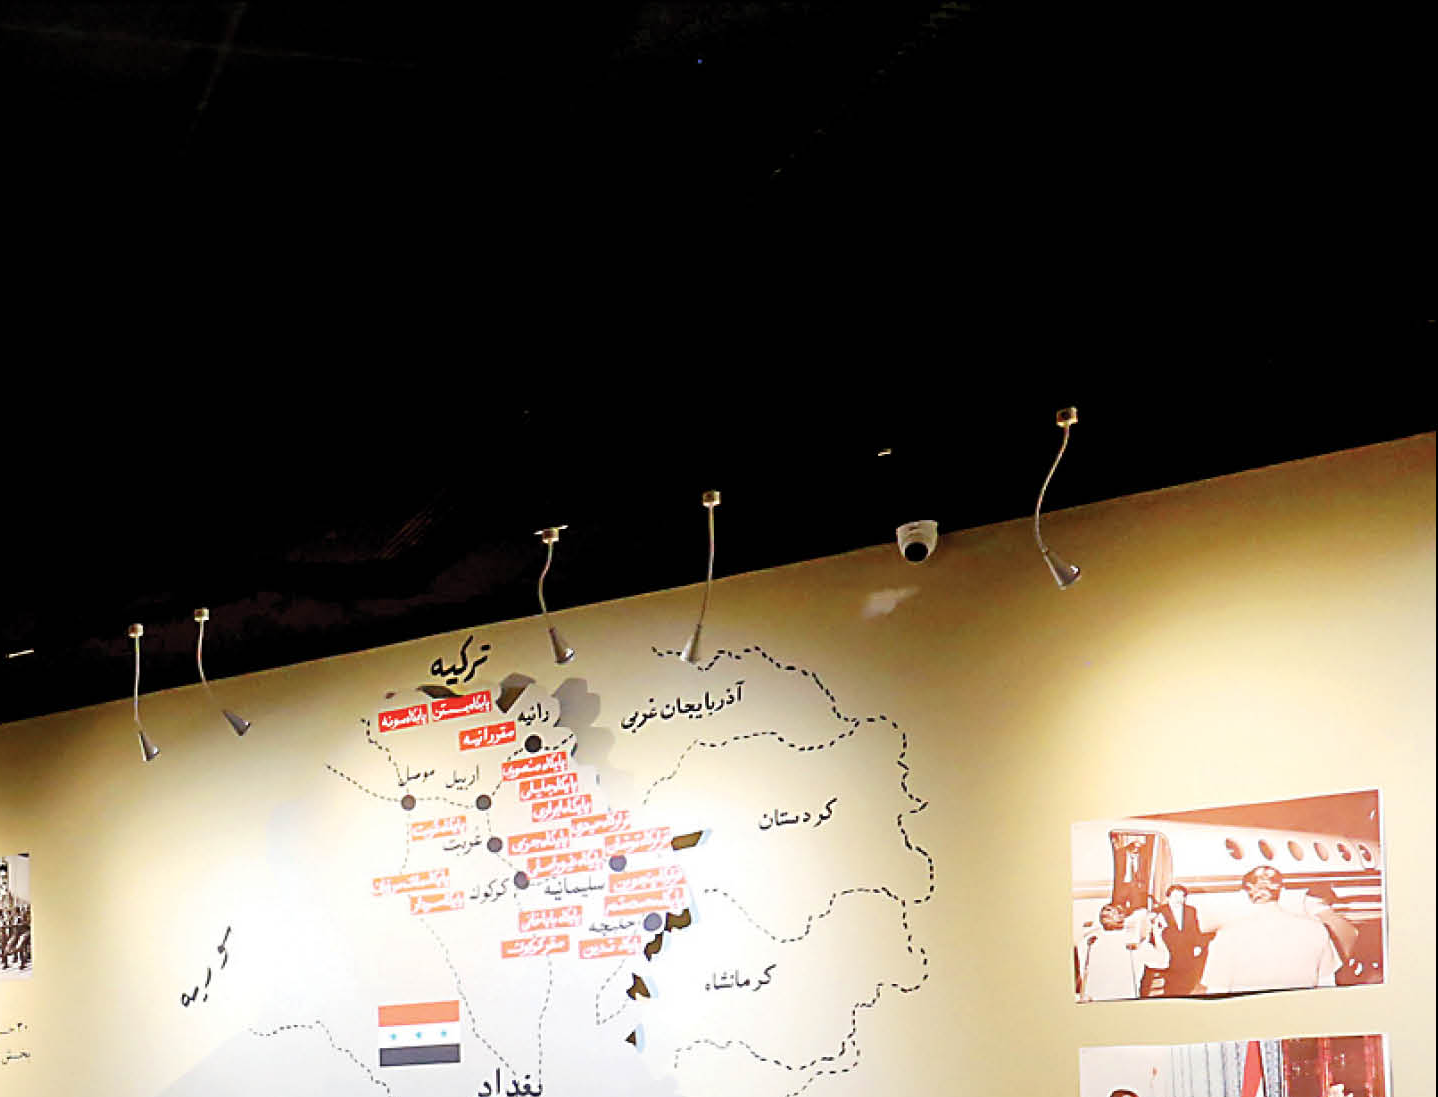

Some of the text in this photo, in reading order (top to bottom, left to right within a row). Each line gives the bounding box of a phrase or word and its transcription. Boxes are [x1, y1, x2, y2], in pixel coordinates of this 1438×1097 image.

[430, 634, 491, 686] ترکیه
[517, 703, 549, 726] رانیه
[619, 680, 746, 732] آذربایجان غربی
[398, 765, 435, 787] موصل
[446, 764, 480, 790] اربیل
[758, 797, 838, 831] کردستان
[544, 875, 604, 901] سلیمانیه
[704, 965, 777, 992] کرمانشاه
